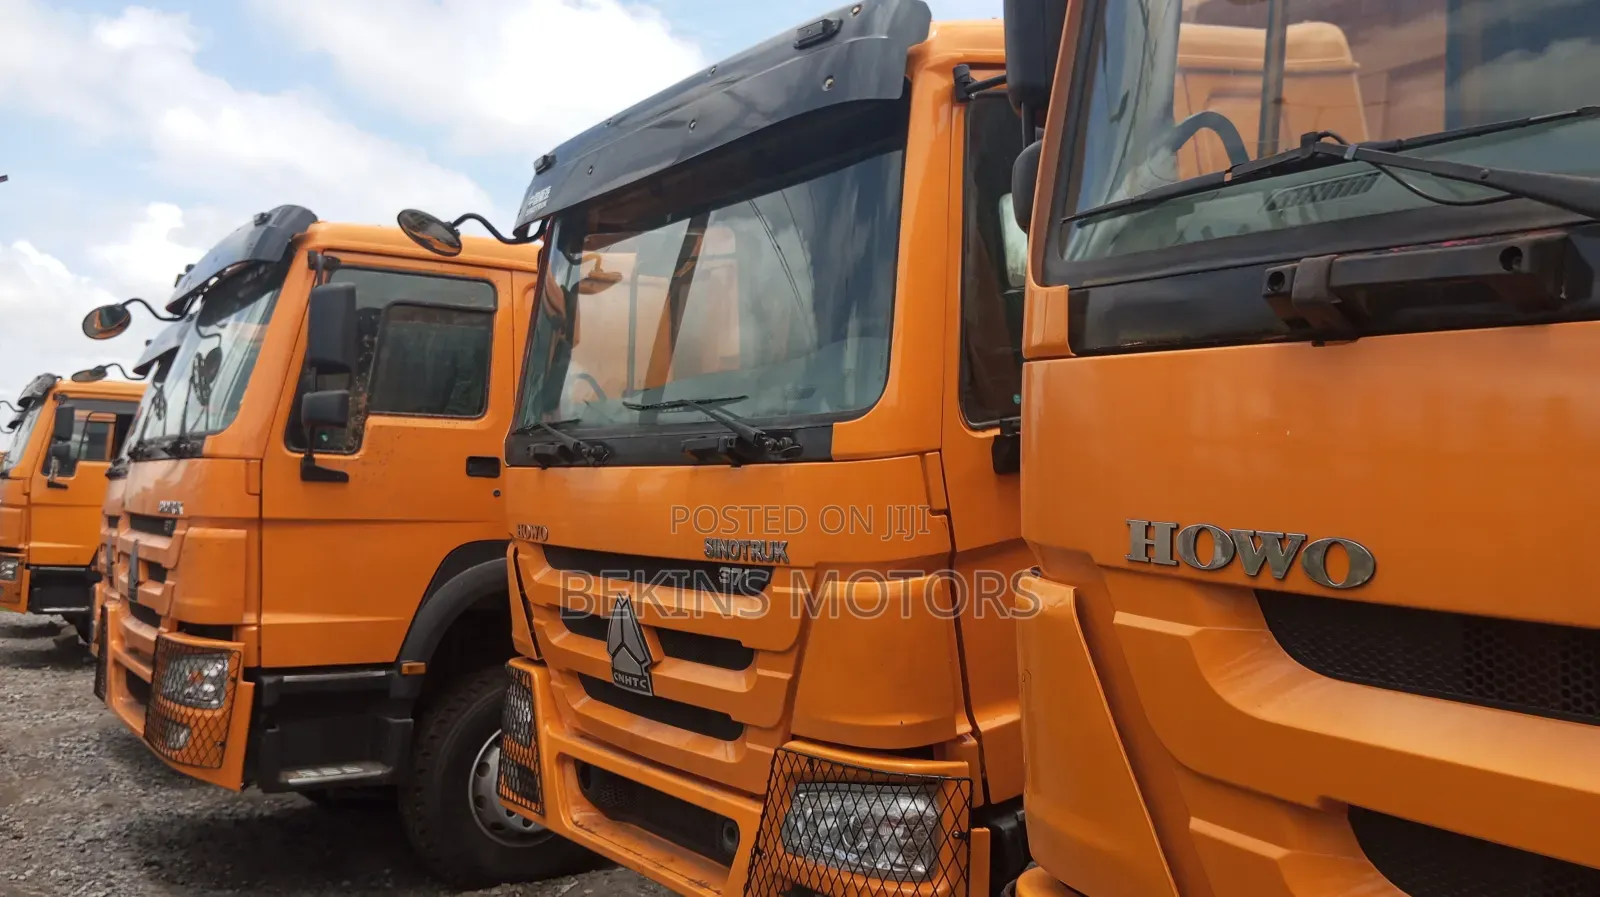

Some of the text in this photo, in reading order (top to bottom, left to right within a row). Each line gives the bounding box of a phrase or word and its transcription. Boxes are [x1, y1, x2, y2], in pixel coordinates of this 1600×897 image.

[517, 524, 549, 541] HOWO
[704, 538, 789, 563] SINOTRUK
[1126, 519, 1376, 589] HOWO
[613, 672, 647, 689] CNHTC
